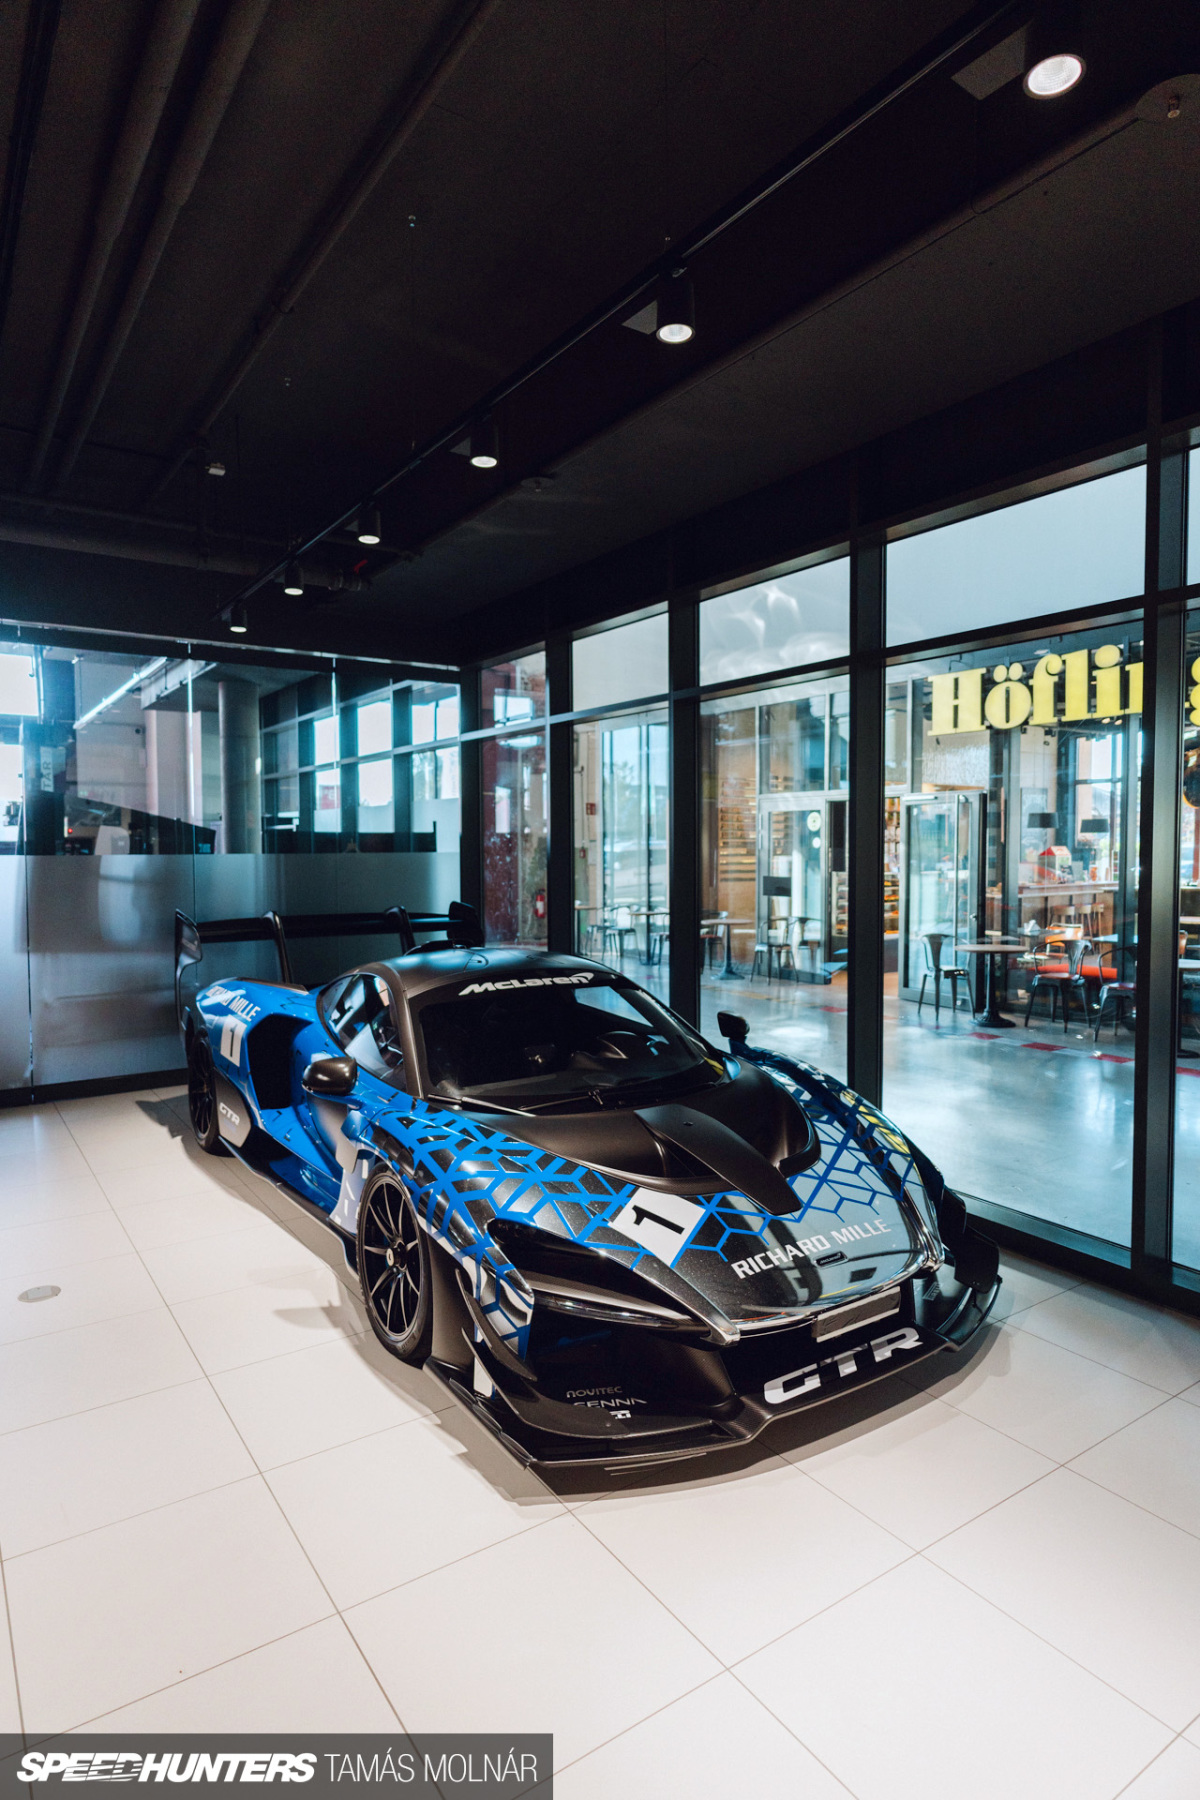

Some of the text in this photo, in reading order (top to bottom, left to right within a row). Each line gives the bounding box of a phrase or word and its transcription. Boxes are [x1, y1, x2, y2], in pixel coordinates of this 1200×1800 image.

[928, 645, 1200, 737] Höfli
[458, 972, 594, 996] McLaren
[228, 996, 261, 1022] MILLE
[229, 1023, 238, 1058] 1
[219, 1102, 240, 1126] GTR
[632, 1204, 685, 1235] 1
[731, 1218, 892, 1279] RICHARD MILLE
[763, 1327, 923, 1404] GTR
